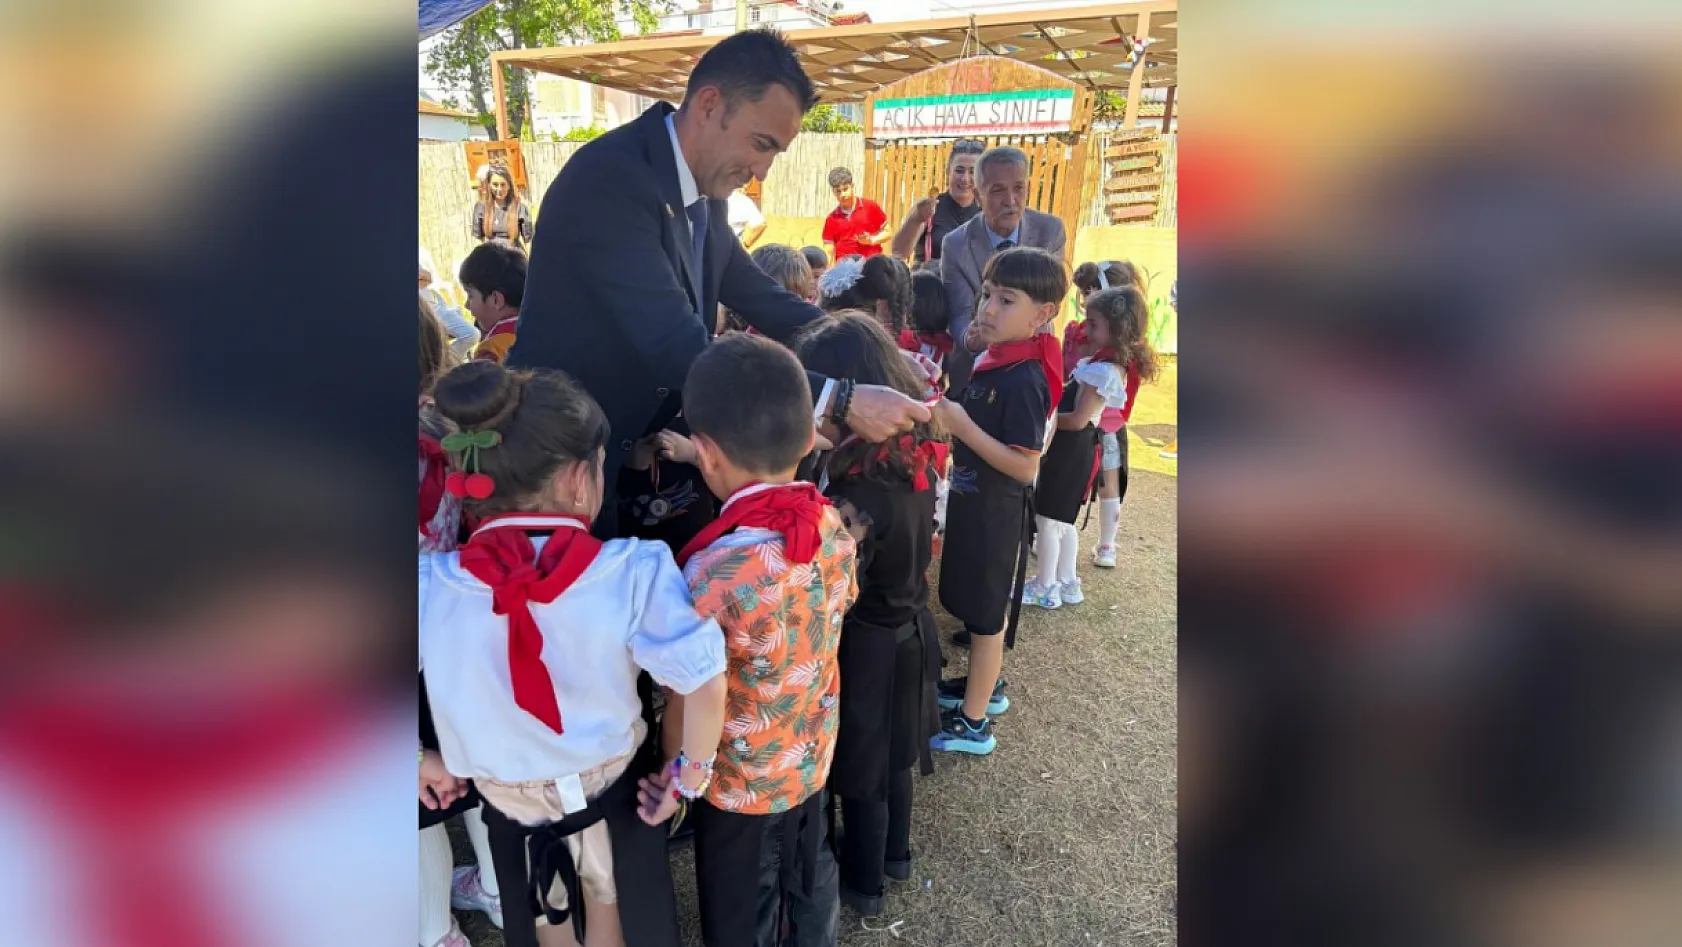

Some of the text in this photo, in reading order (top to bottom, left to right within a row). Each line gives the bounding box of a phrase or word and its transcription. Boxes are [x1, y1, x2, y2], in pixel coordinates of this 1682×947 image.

[883, 98, 1056, 128] AÇIK HAVA SINIFI
